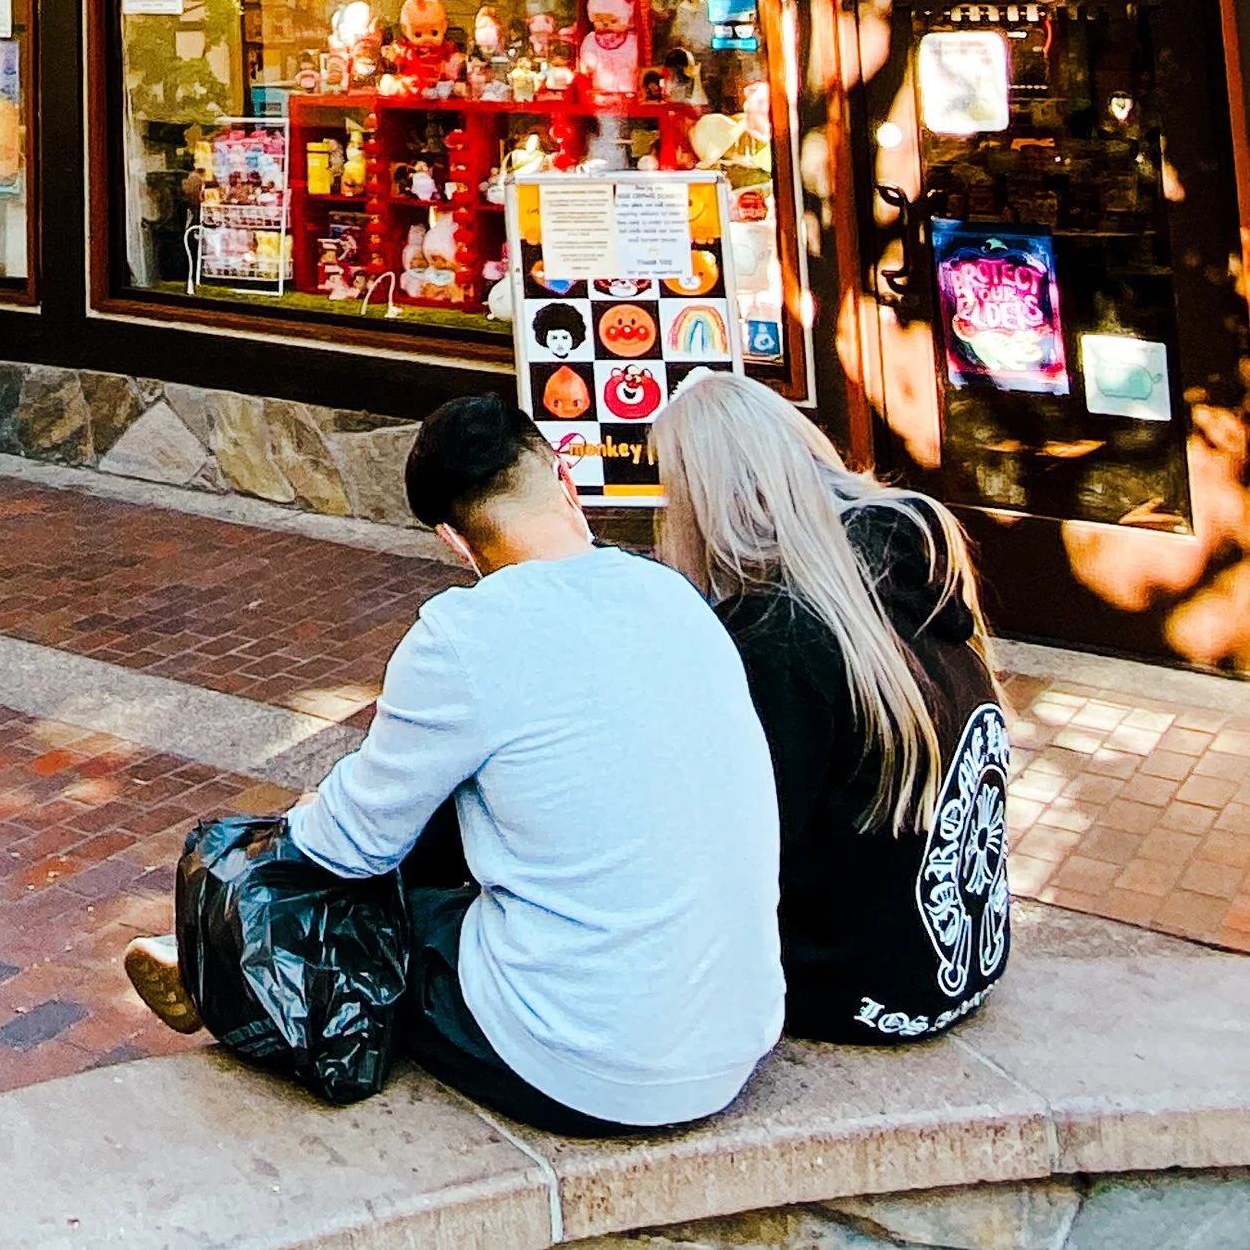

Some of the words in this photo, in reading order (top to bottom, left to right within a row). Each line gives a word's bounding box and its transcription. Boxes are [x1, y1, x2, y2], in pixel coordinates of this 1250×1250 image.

[950, 258, 1044, 298] PROTECT
[978, 284, 1018, 302] OUR
[957, 293, 1044, 331] ELDERS
[568, 435, 643, 465] monkey
